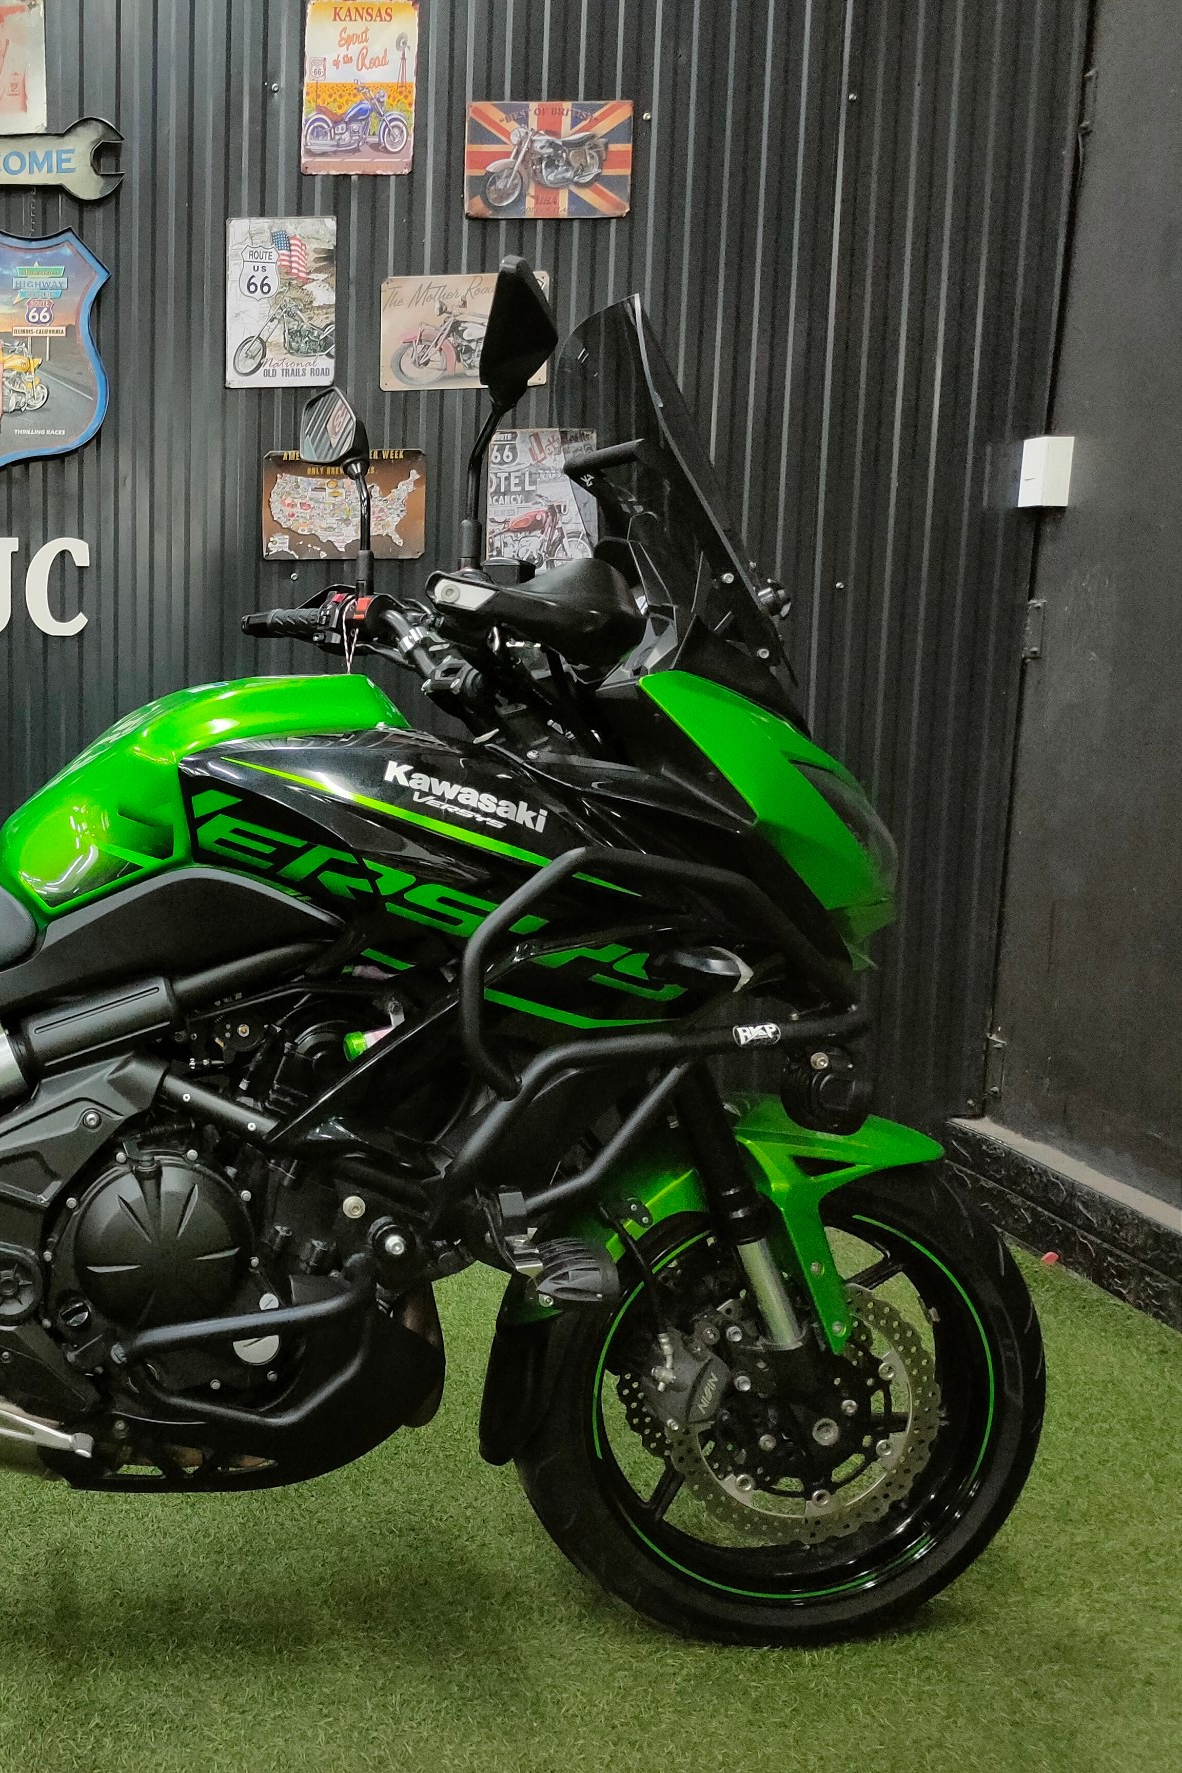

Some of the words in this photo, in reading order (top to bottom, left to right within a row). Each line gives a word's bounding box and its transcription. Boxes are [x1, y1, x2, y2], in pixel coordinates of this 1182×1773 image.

[332, 6, 393, 22] KANSAS
[337, 27, 370, 51] Spirit
[332, 53, 341, 70] of
[343, 52, 353, 65] the
[356, 46, 389, 72] Road
[248, 251, 273, 261] ROUTE
[15, 280, 64, 288] HIGHWAY
[246, 275, 272, 295] 66
[382, 285, 403, 312] The
[408, 281, 460, 307] Mother
[28, 307, 50, 322] 66
[261, 354, 319, 368] National
[263, 368, 277, 378] OLD
[281, 368, 307, 377] TRAILS
[310, 367, 330, 377] ROAD
[382, 450, 404, 459] WEEK
[490, 444, 513, 463] 66
[384, 760, 549, 833] Kawasaki
[412, 791, 508, 829] VERSYS
